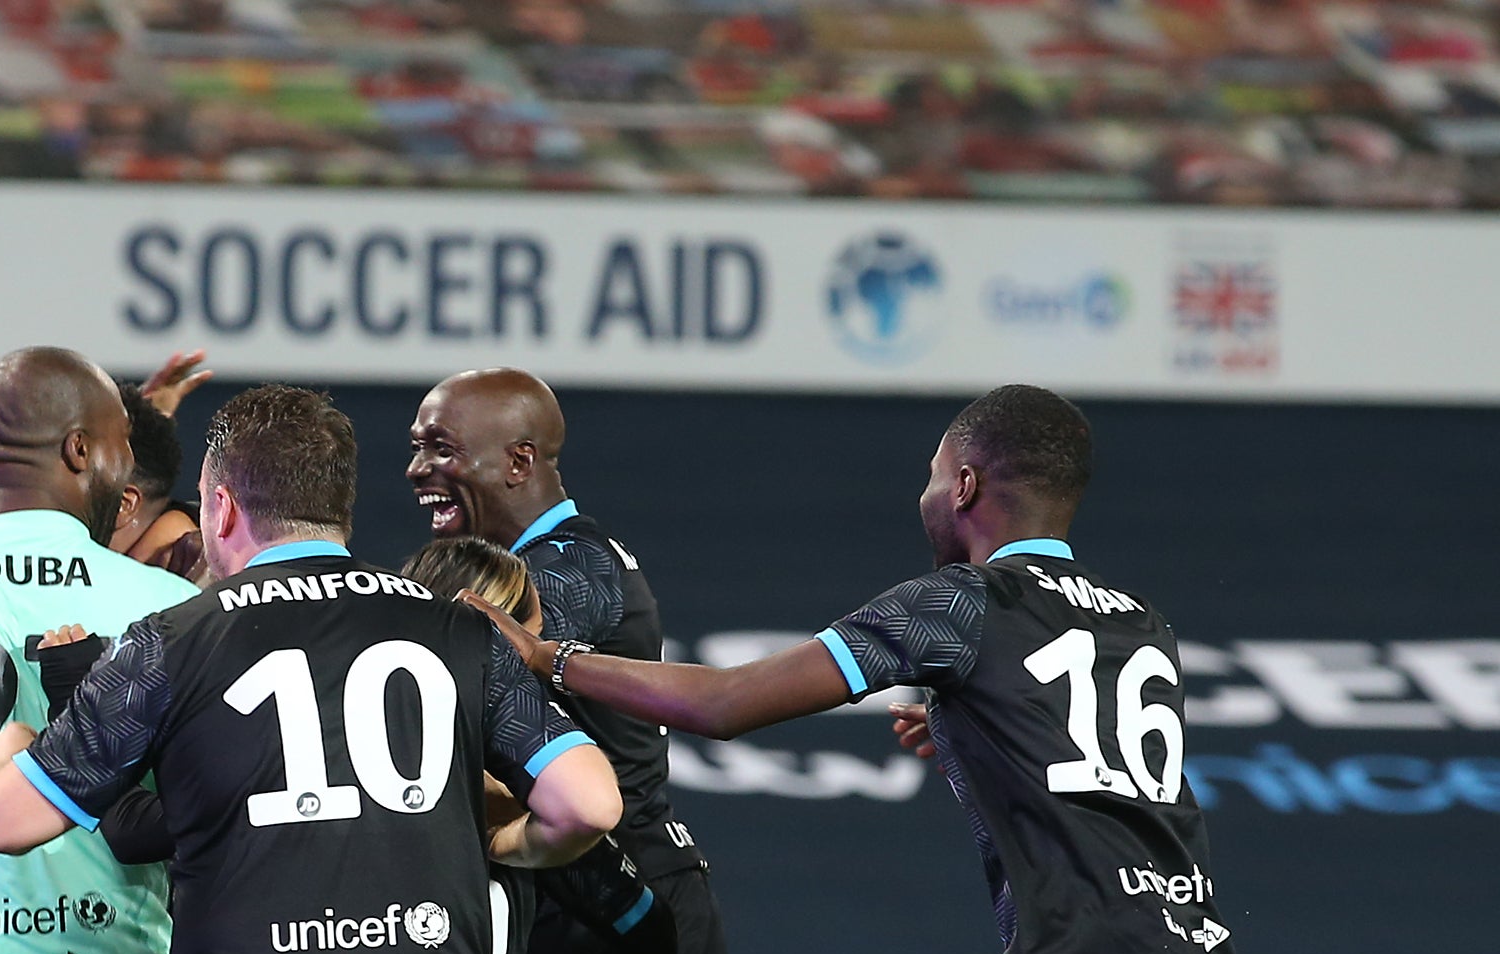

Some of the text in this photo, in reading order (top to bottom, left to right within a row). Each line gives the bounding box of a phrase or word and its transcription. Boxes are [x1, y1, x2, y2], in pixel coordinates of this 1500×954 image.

[122, 225, 767, 344] SOCCER AID
[217, 570, 435, 612] MANFORD
[222, 639, 457, 828] 10
[1022, 628, 1184, 804] 16
[270, 903, 402, 952] unicef
[1191, 922, 1227, 948] stv
